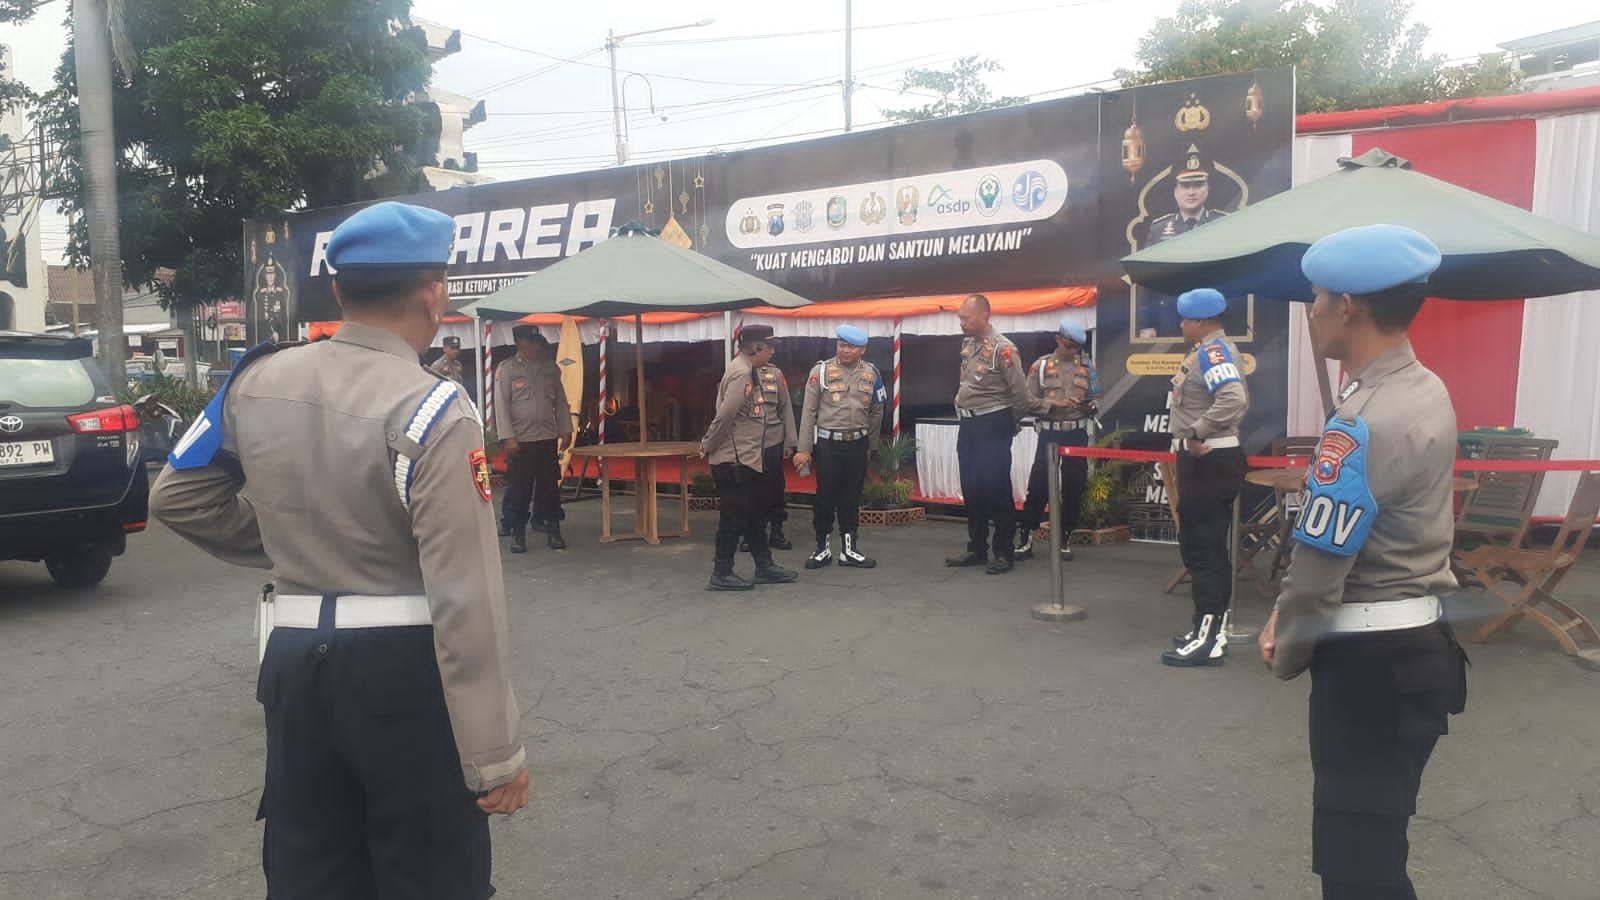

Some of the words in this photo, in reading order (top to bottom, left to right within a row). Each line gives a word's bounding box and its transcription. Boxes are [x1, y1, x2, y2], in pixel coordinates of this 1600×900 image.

[936, 199, 971, 216] asdp
[448, 198, 616, 265] AREA
[790, 246, 854, 269] MENGABDI
[857, 243, 886, 263] DAN
[888, 237, 945, 260] SANTUN
[465, 279, 498, 294] KETUPAT
[33, 442, 50, 456] PW
